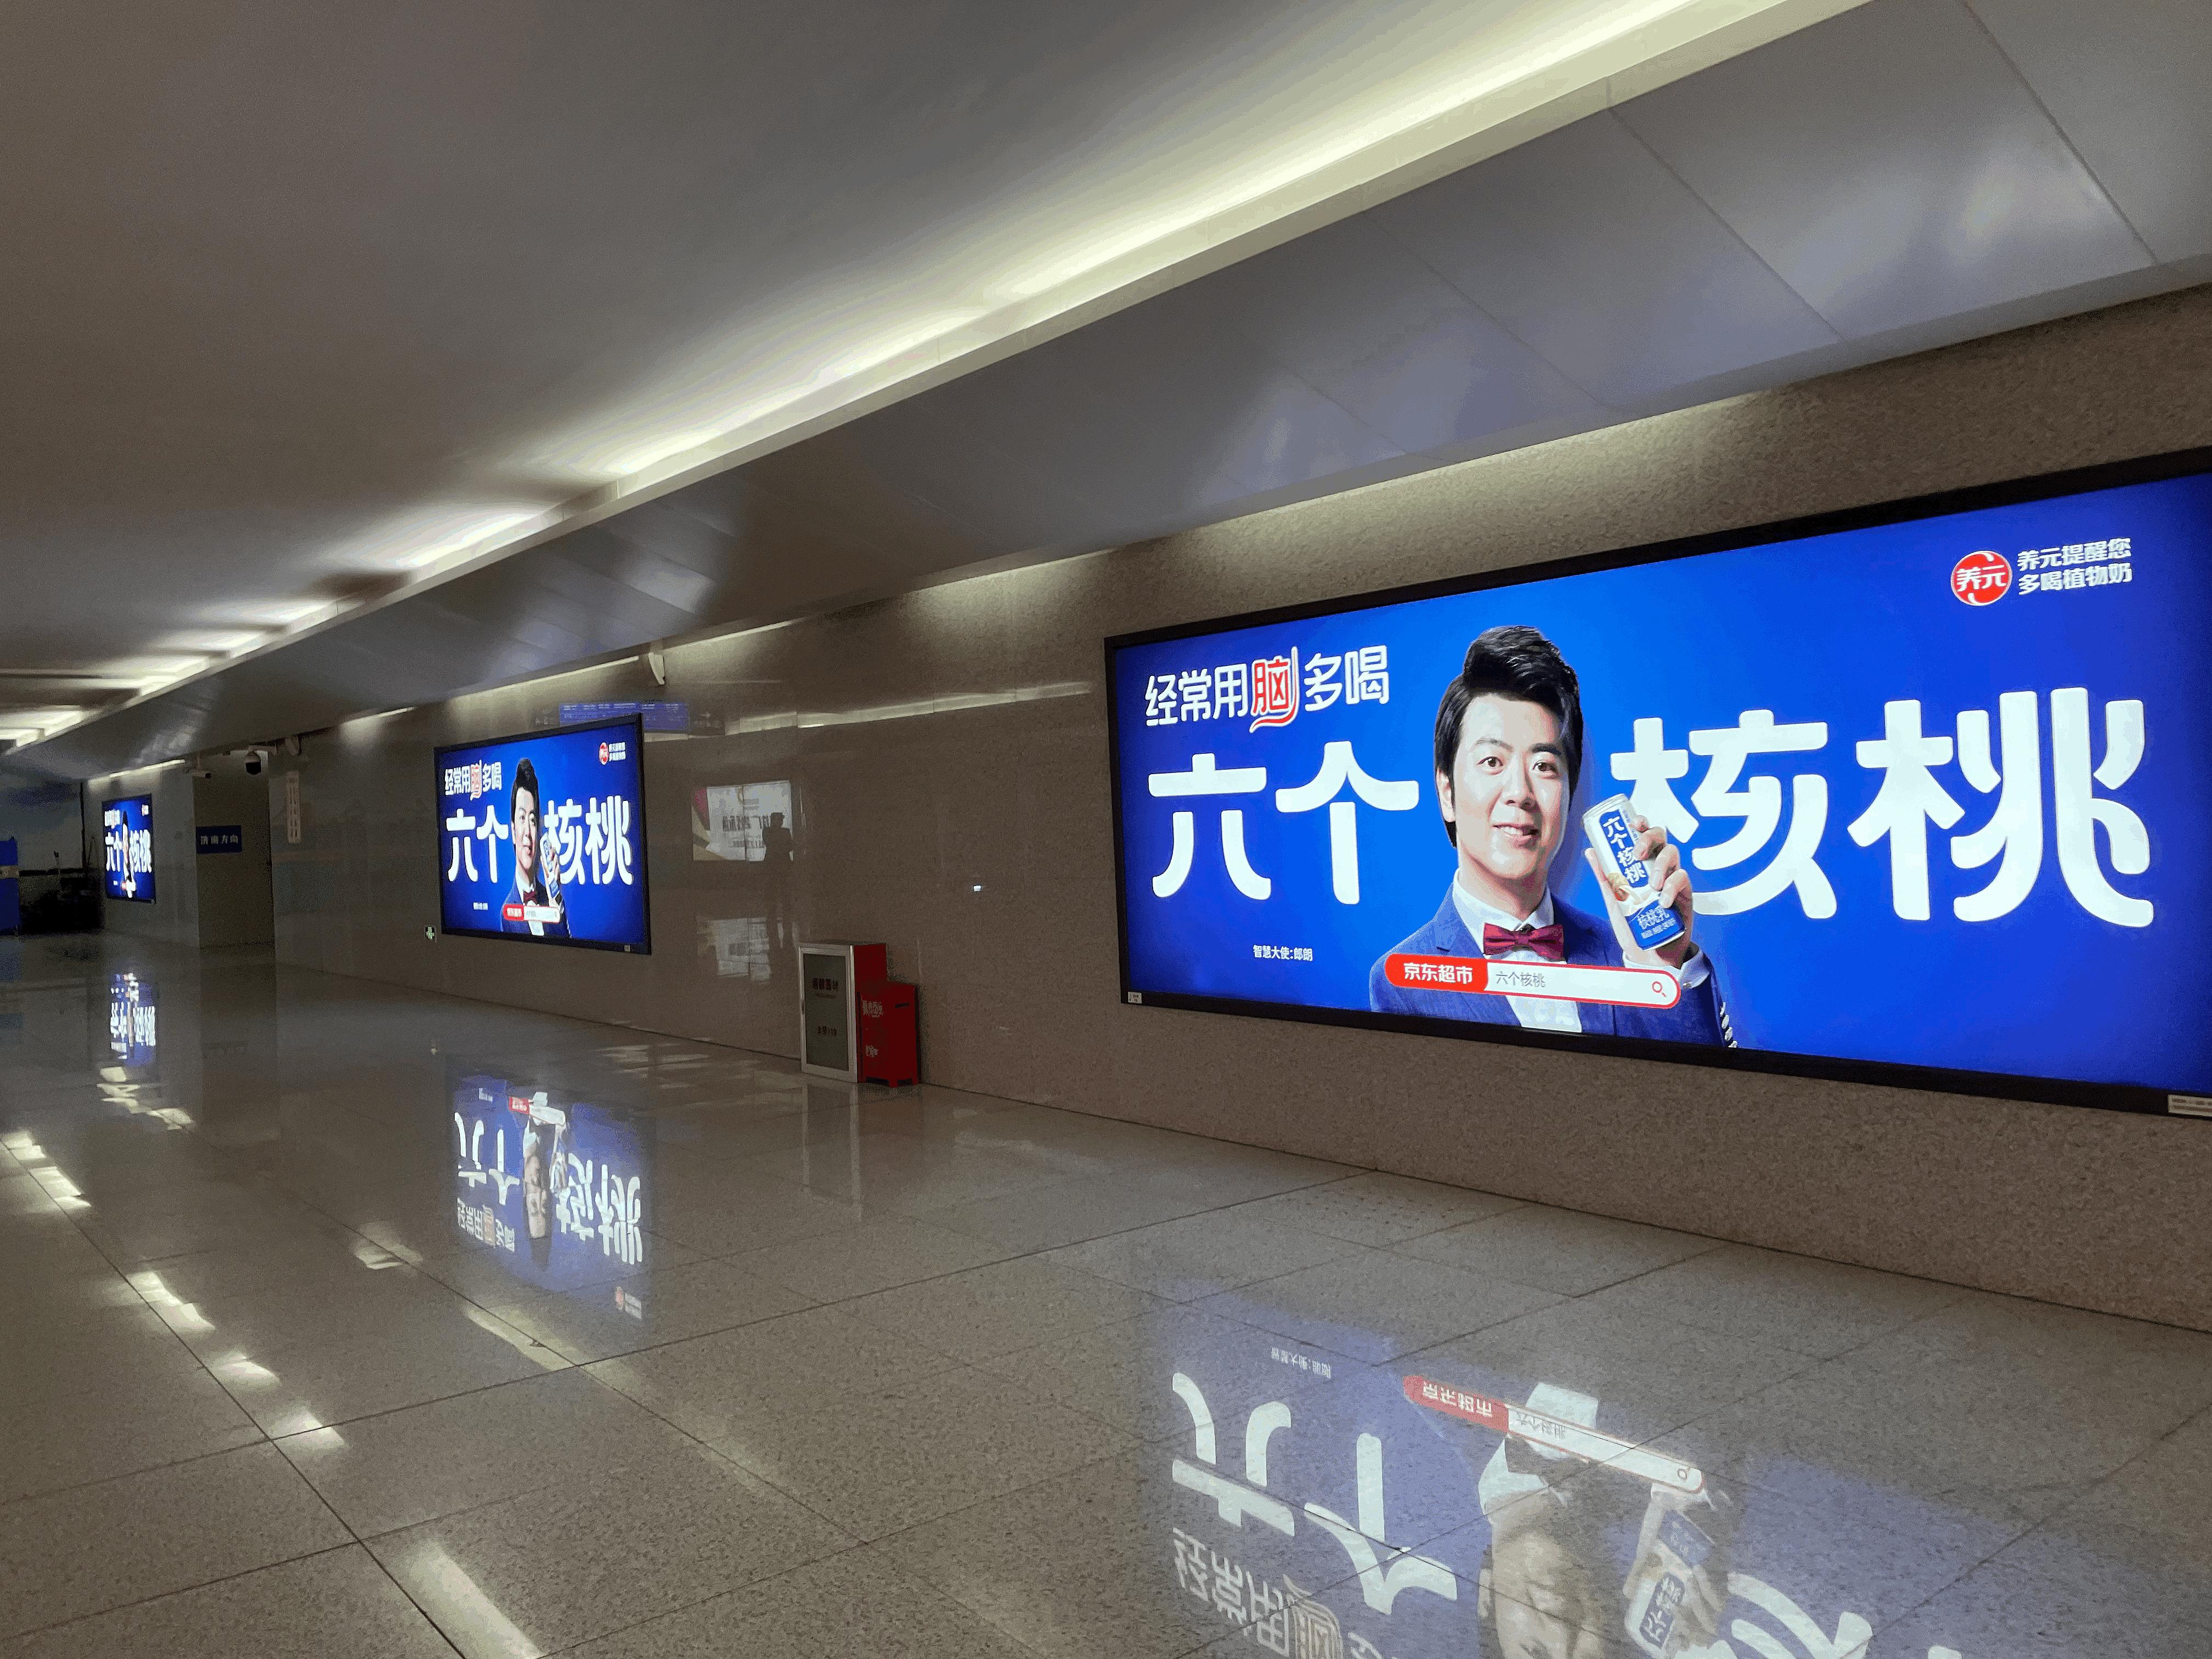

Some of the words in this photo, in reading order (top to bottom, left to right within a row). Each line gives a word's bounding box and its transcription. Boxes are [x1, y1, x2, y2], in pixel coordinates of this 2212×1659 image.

[2017, 537, 2132, 571] 养元提醒您
[1956, 564, 2008, 592] 养元
[2018, 562, 2133, 595] 多喝植物奶
[1144, 644, 1390, 733] 经常用脑多喝
[1147, 741, 1419, 905] 六个
[1610, 687, 2154, 928] 核桃
[445, 805, 509, 884] 六个
[544, 795, 634, 885] 核桃
[1602, 816, 1646, 884] 六个核桃
[1403, 961, 1473, 985] 京东超市
[1495, 971, 1546, 989] 六个核桃
